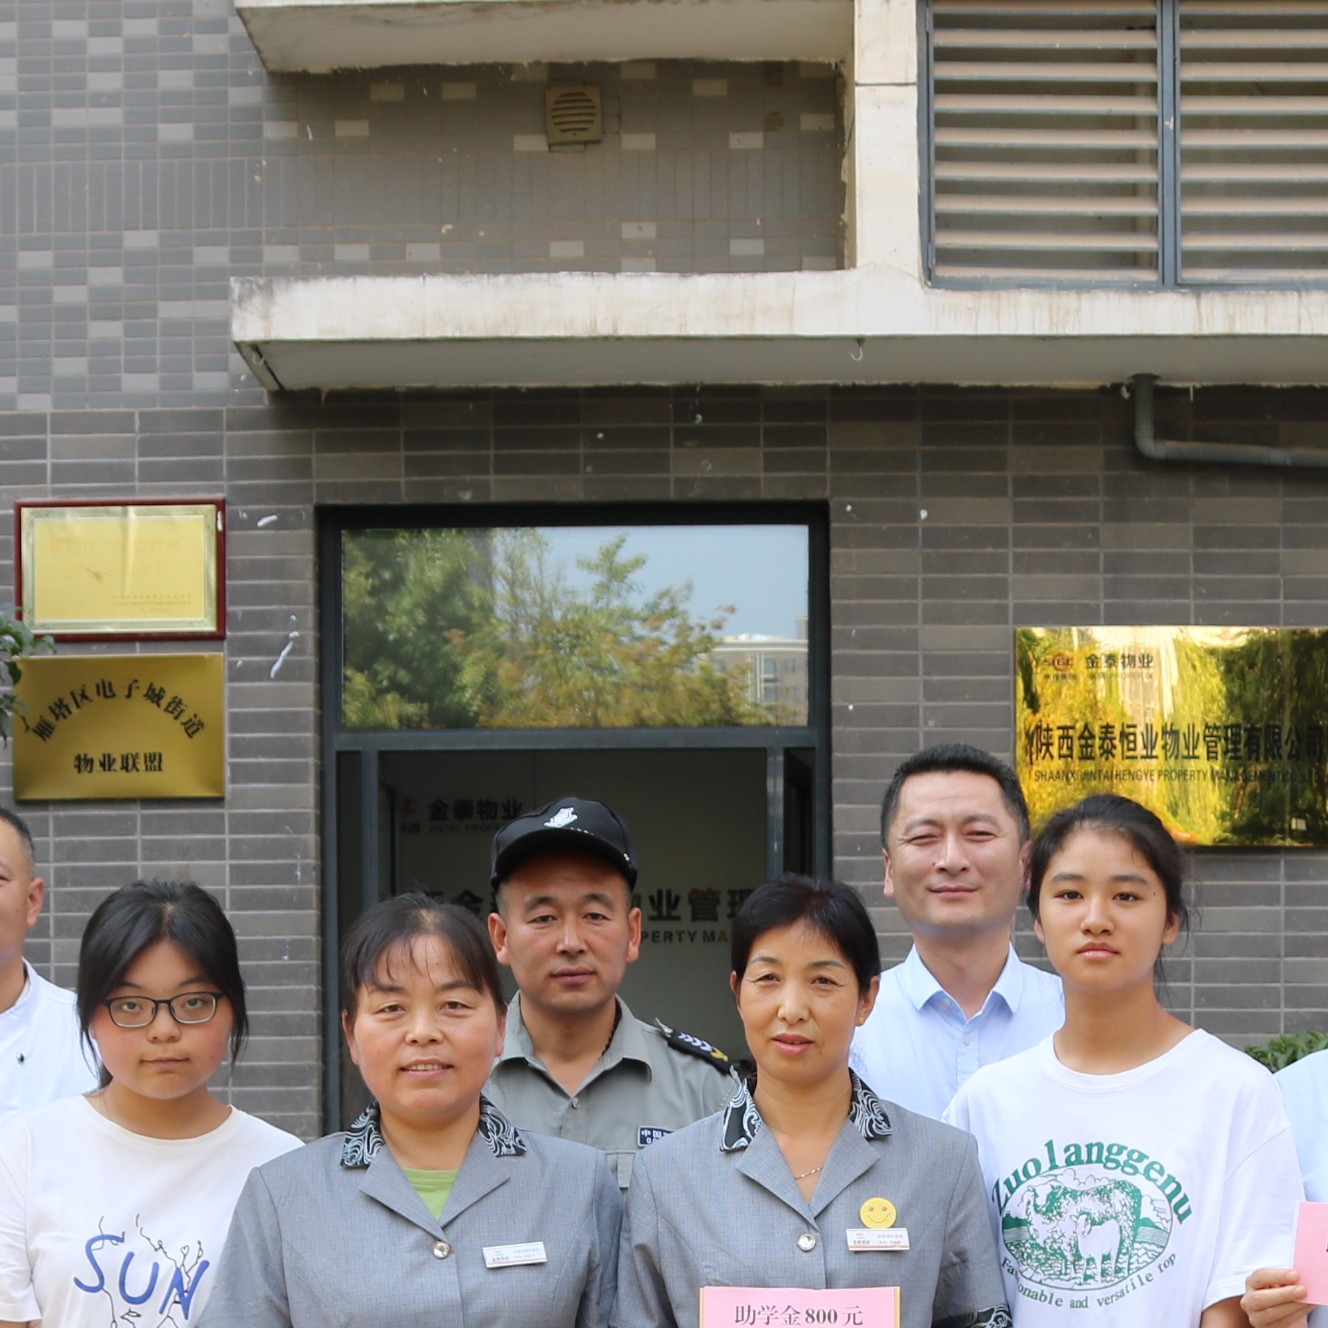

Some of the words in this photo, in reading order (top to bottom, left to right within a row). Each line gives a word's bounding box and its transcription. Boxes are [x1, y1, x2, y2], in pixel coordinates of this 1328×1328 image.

[1085, 653, 1154, 669] 金泰物业
[32, 678, 205, 742] 雁塔区电子城街道
[1034, 722, 1323, 761] 陕西金泰恒业物业管理有限公司
[74, 752, 163, 774] 物业联盟
[1157, 769, 1208, 782] PROPERTY
[428, 798, 522, 821] 金泰物业
[992, 1139, 1193, 1225] Zuolanggenu
[73, 1234, 210, 1321] SUN
[1002, 1256, 1064, 1307] Fasonable
[1069, 1296, 1089, 1309] and
[1096, 1271, 1155, 1308] versatile
[1158, 1252, 1177, 1274] top
